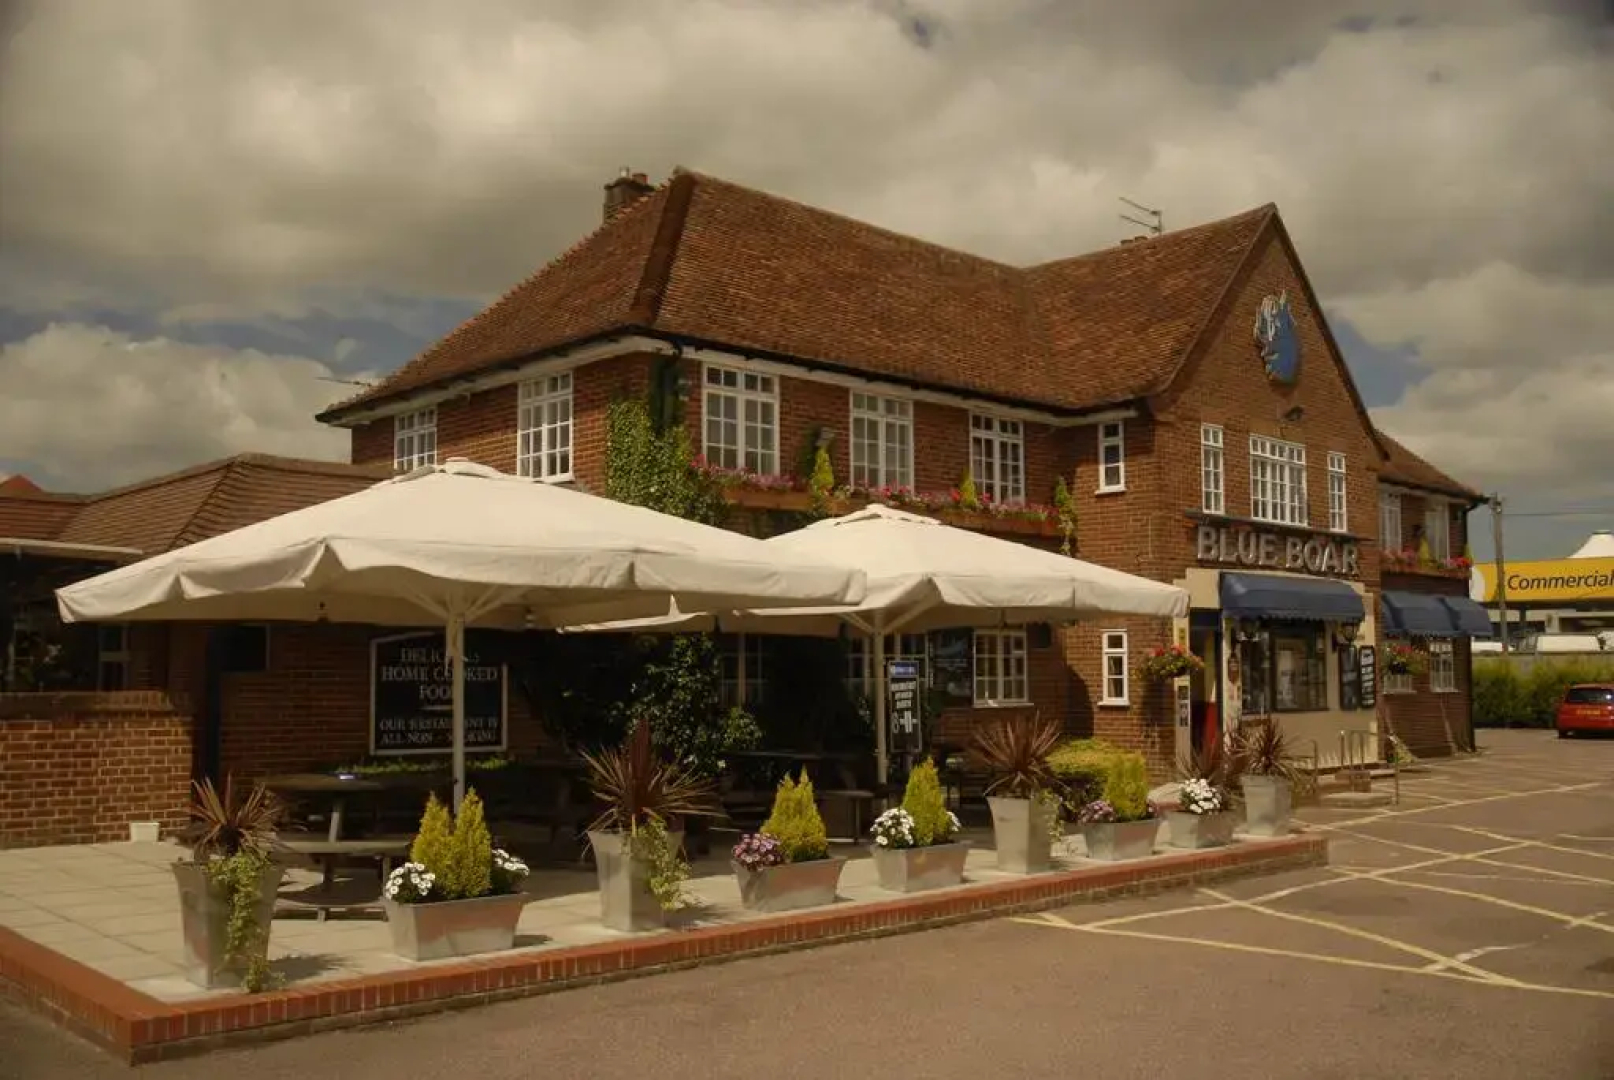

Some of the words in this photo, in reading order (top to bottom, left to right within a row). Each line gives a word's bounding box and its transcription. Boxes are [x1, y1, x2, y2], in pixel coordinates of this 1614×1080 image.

[1197, 525, 1277, 566] BLUE
[1286, 535, 1359, 575] BOAR
[1507, 569, 1614, 591] Commercial
[381, 665, 429, 681] HOME
[433, 665, 498, 681] COKED
[418, 685, 455, 700] FOO
[380, 716, 406, 731] OUR
[380, 732, 405, 745] ALL
[407, 732, 433, 744] NON
